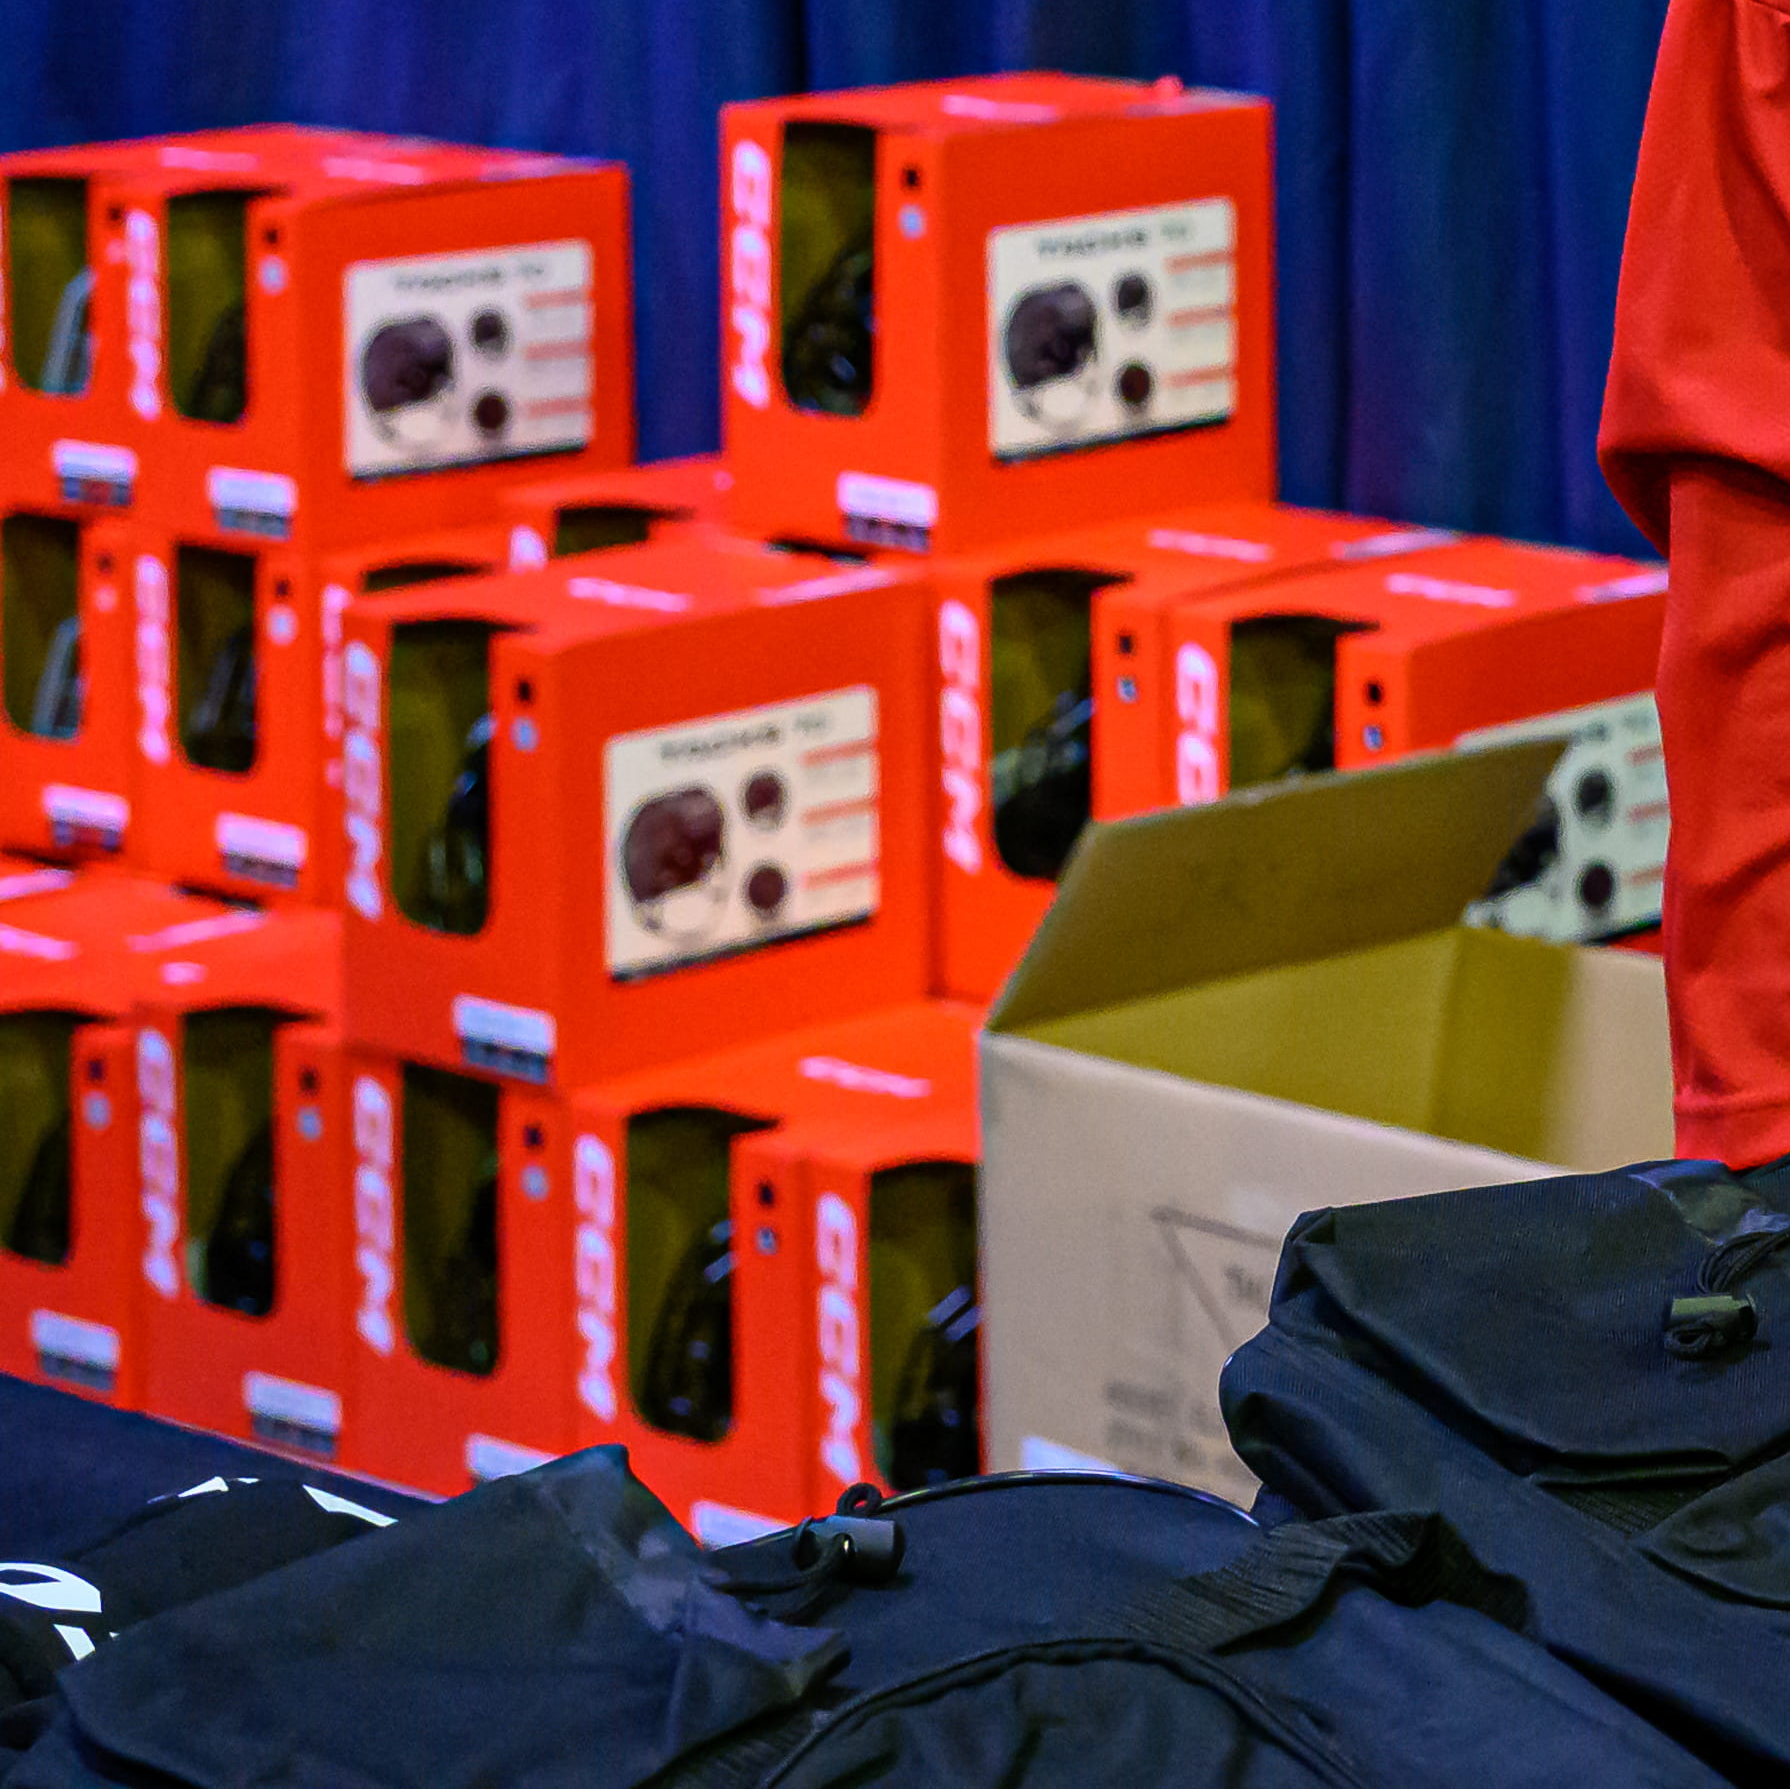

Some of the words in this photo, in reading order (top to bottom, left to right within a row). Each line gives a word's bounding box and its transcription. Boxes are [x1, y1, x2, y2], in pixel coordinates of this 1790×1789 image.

[729, 138, 773, 410] CCM
[938, 598, 983, 875] CCM
[573, 1133, 618, 1424] CCM
